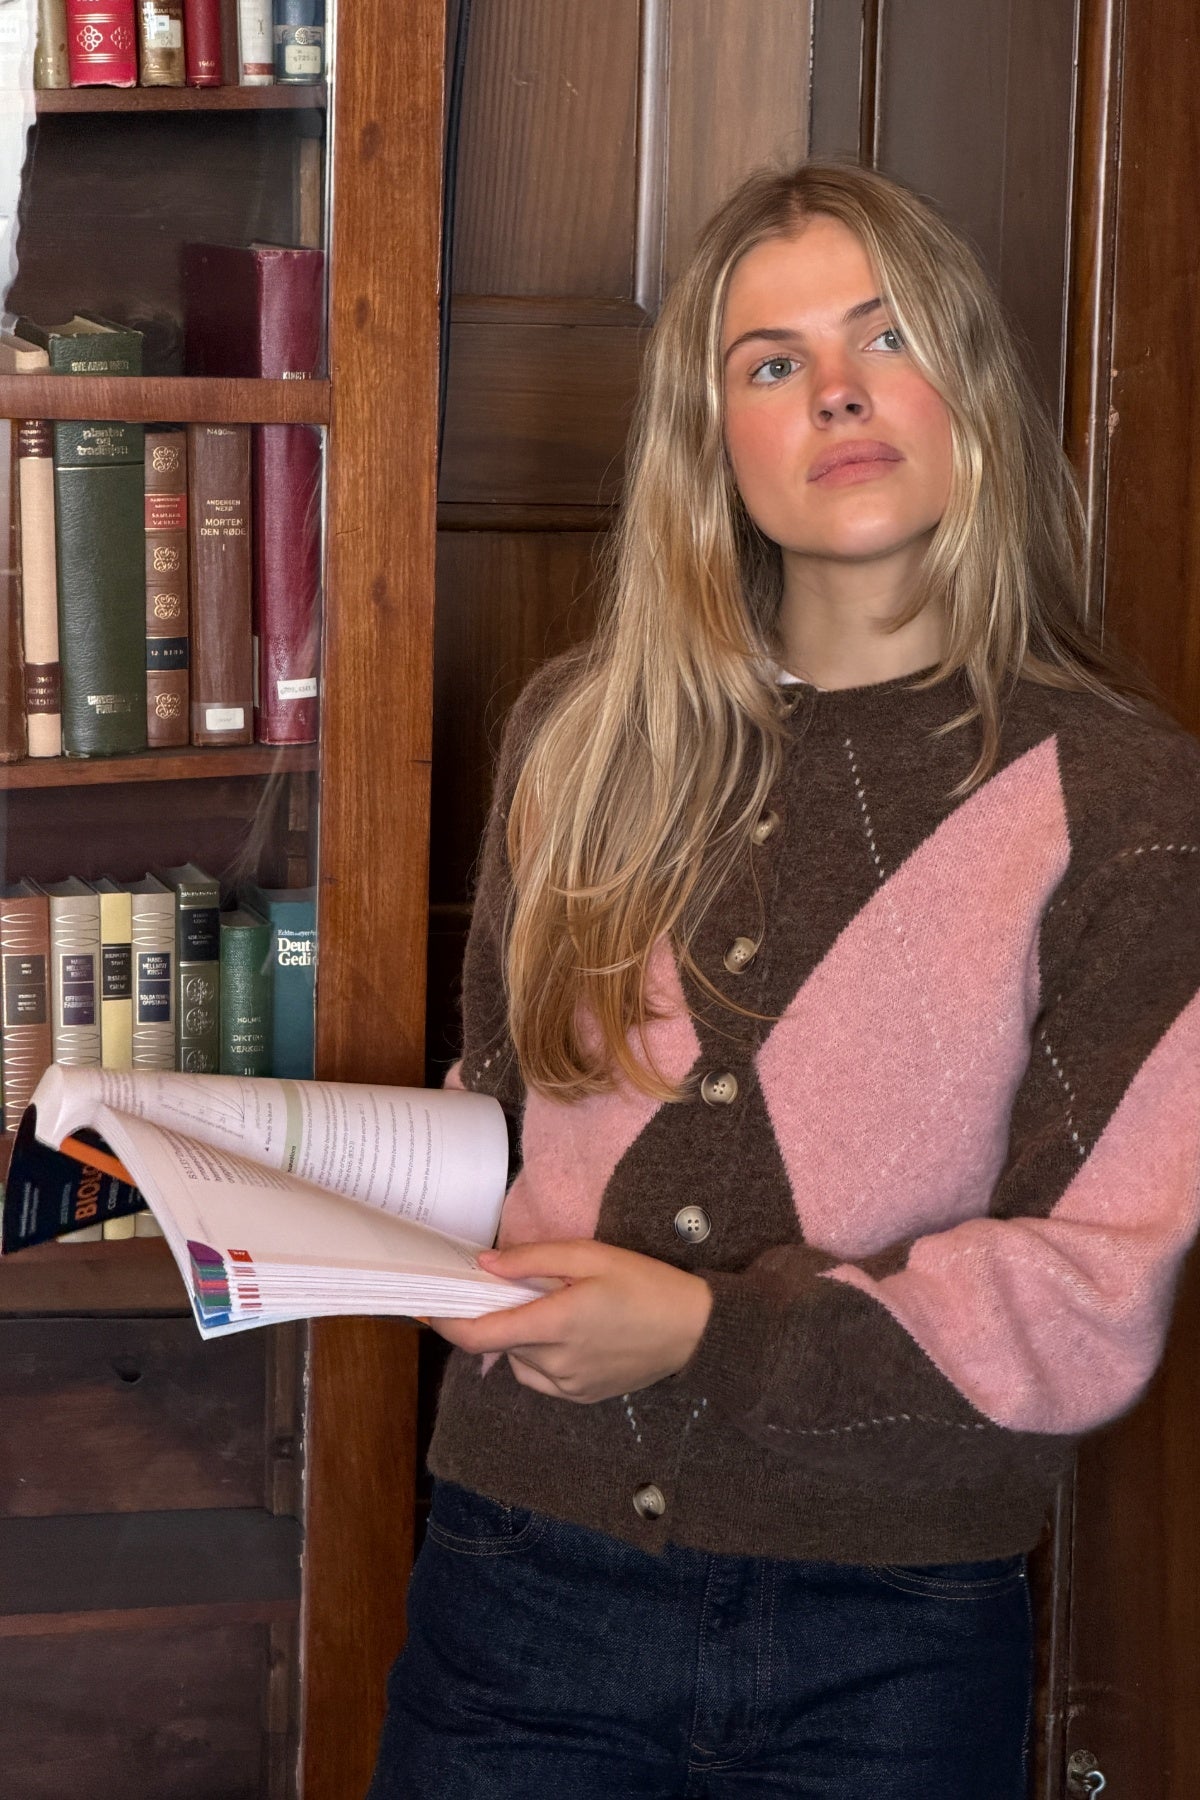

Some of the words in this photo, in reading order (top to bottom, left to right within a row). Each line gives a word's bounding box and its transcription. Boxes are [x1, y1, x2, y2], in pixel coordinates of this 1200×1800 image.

[205, 518, 243, 526] MORTEN
[200, 528, 219, 536] DEN
[223, 528, 247, 536] RØDE
